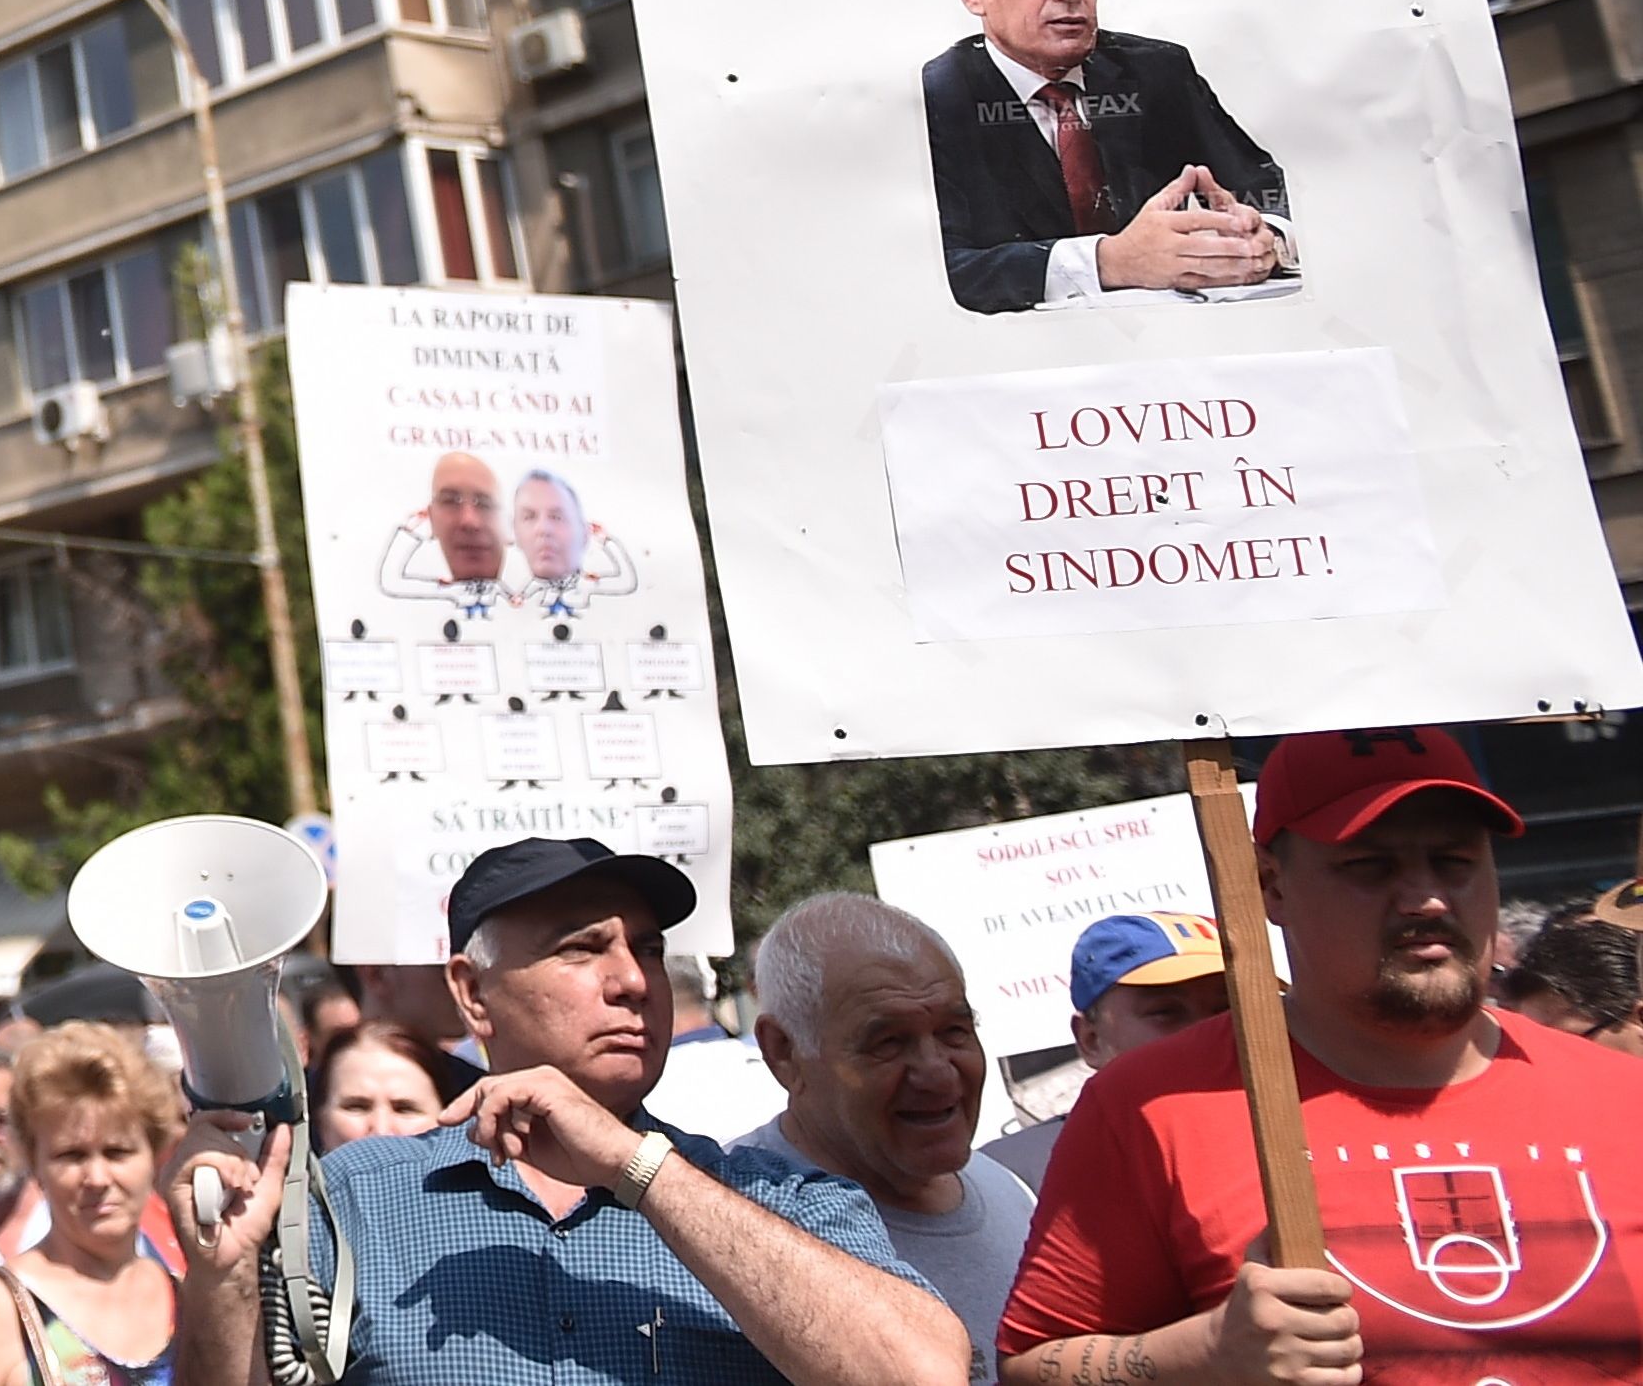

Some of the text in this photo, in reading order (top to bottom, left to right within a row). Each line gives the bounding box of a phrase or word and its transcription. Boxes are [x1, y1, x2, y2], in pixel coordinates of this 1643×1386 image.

[390, 307, 578, 335] LA RAPORT DE
[1030, 398, 1256, 450] LOVIND
[1016, 457, 1300, 521] DREPT ÎN
[1005, 536, 1333, 594] SINDOMET!
[999, 974, 1070, 999] NIMEN
